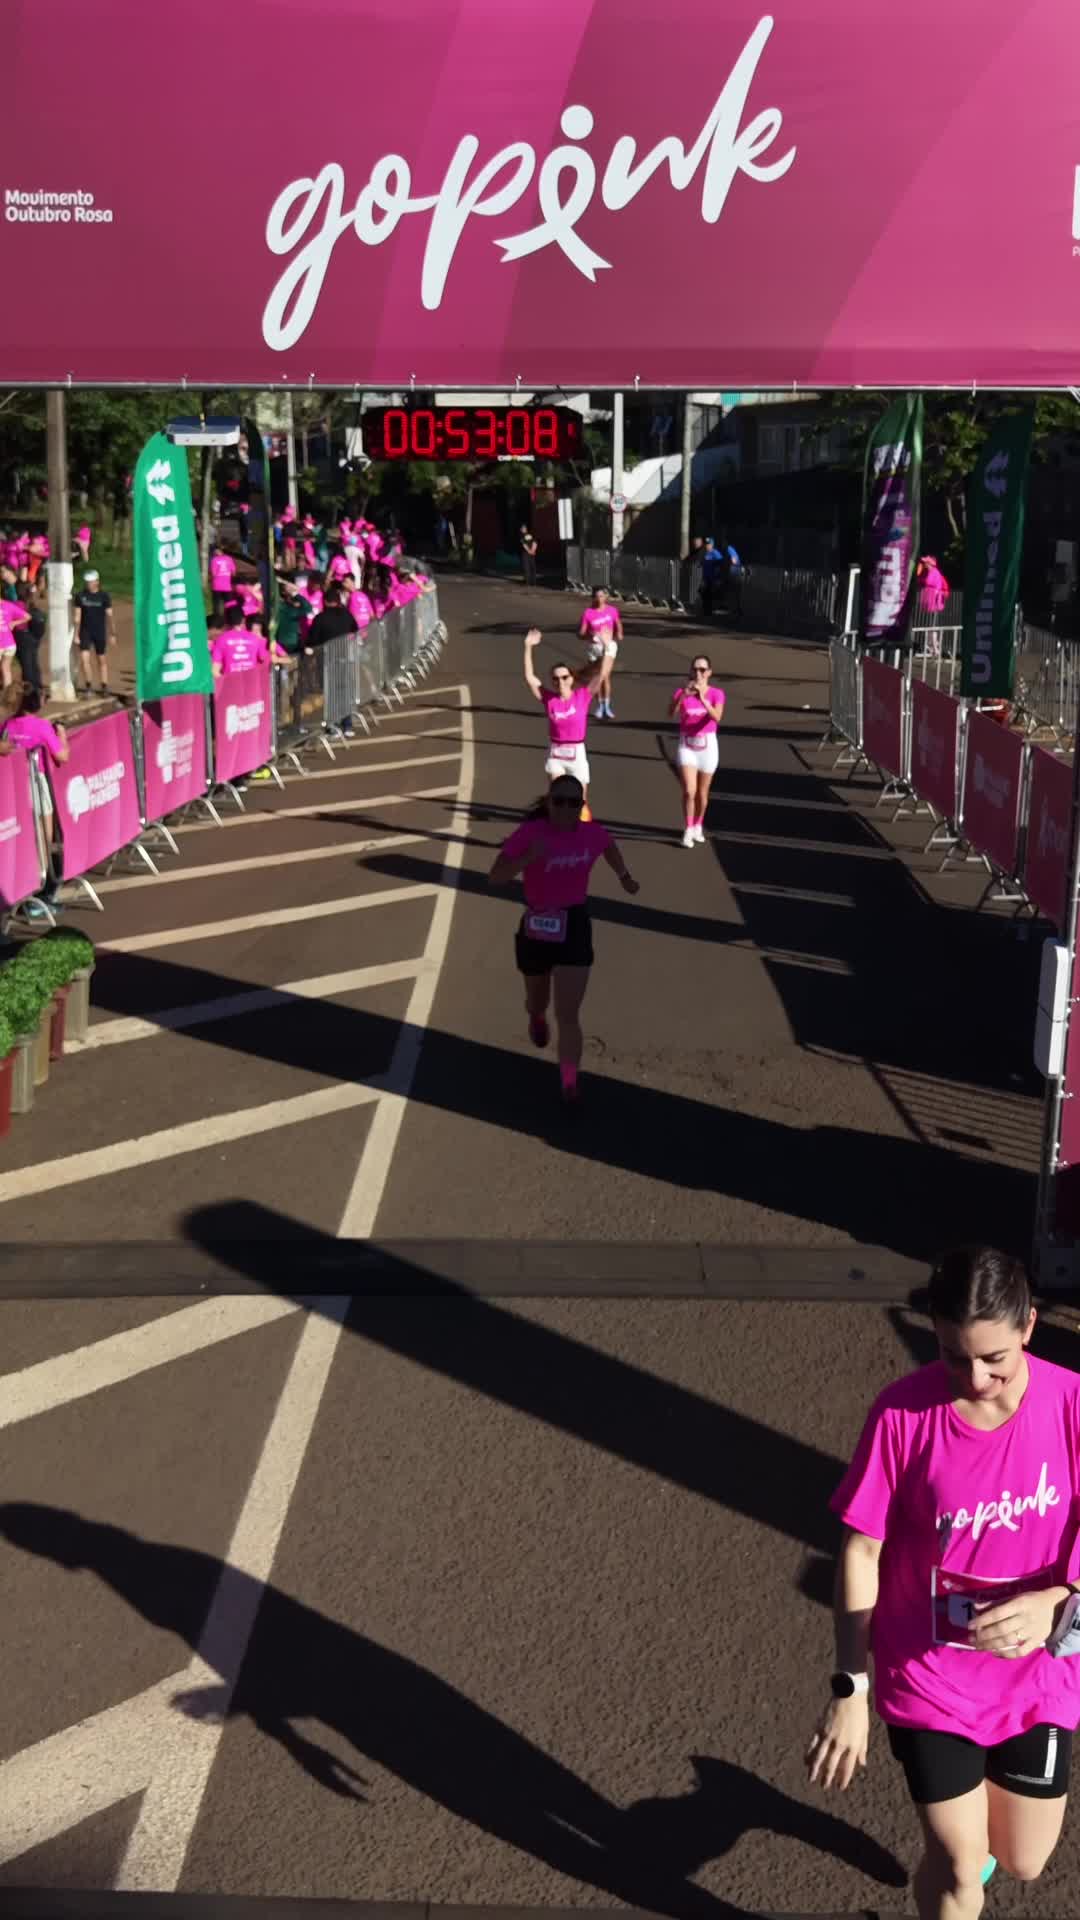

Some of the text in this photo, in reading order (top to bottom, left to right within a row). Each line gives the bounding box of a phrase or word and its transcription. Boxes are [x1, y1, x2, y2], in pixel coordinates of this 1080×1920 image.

[5, 206, 113, 222] Outubro Rosa
[262, 15, 797, 352] gopink
[384, 410, 558, 454] 00:53:08
[151, 514, 194, 683] Unimed
